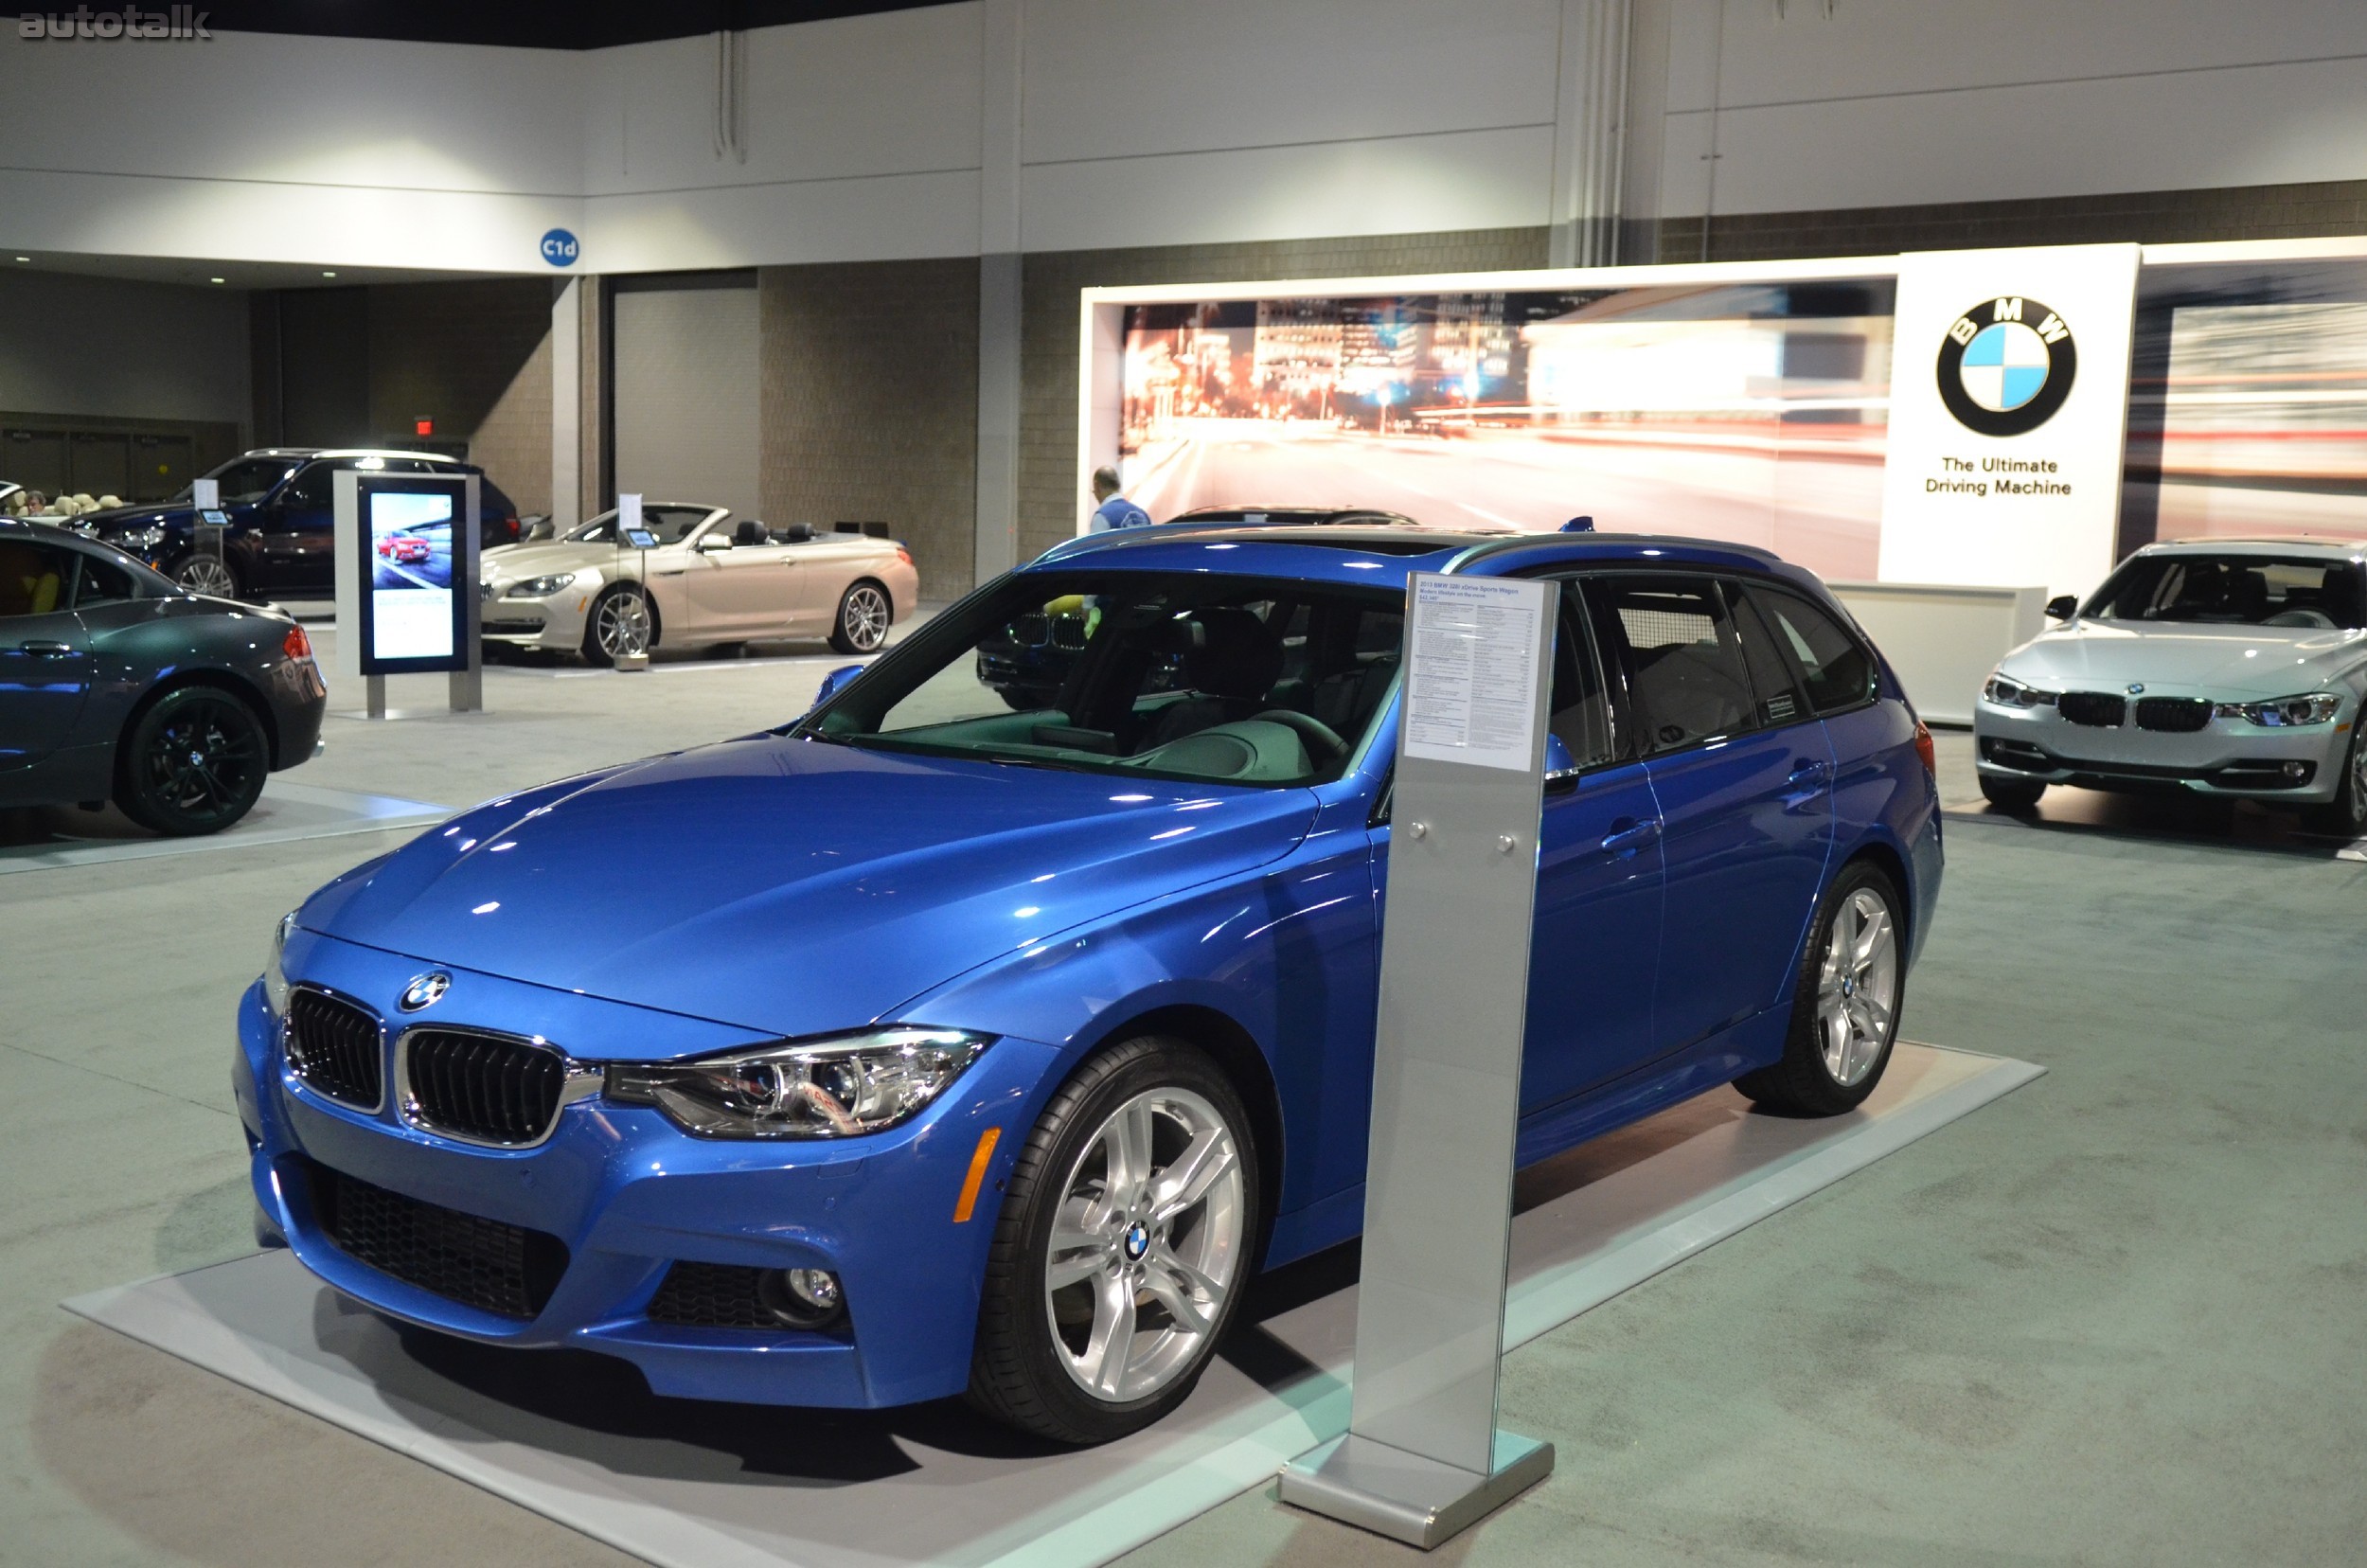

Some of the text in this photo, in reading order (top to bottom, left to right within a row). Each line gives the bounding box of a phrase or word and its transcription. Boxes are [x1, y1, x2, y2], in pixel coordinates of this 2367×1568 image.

[543, 240, 577, 258] C1d
[1949, 297, 2069, 347] BMW
[1942, 457, 2058, 473] The Ultimate
[1926, 479, 2072, 496] Driving Machine
[1479, 585, 1498, 594] Sports
[1499, 587, 1519, 596] Wagon
